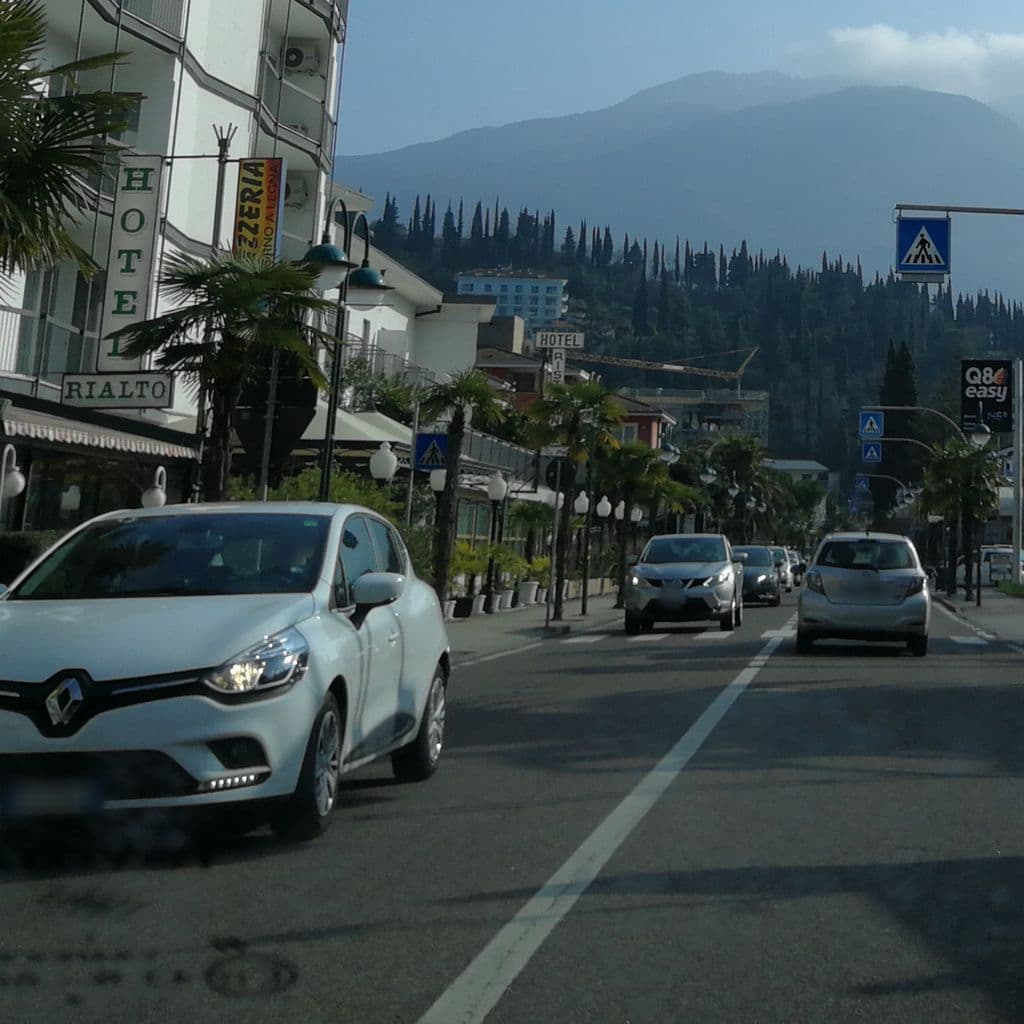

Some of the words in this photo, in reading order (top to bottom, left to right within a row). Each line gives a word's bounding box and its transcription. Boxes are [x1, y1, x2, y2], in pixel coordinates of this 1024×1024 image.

[540, 334, 580, 347] HOTEL
[965, 366, 994, 385] Q8
[64, 380, 166, 400] RIALTO
[965, 385, 1008, 403] easy
